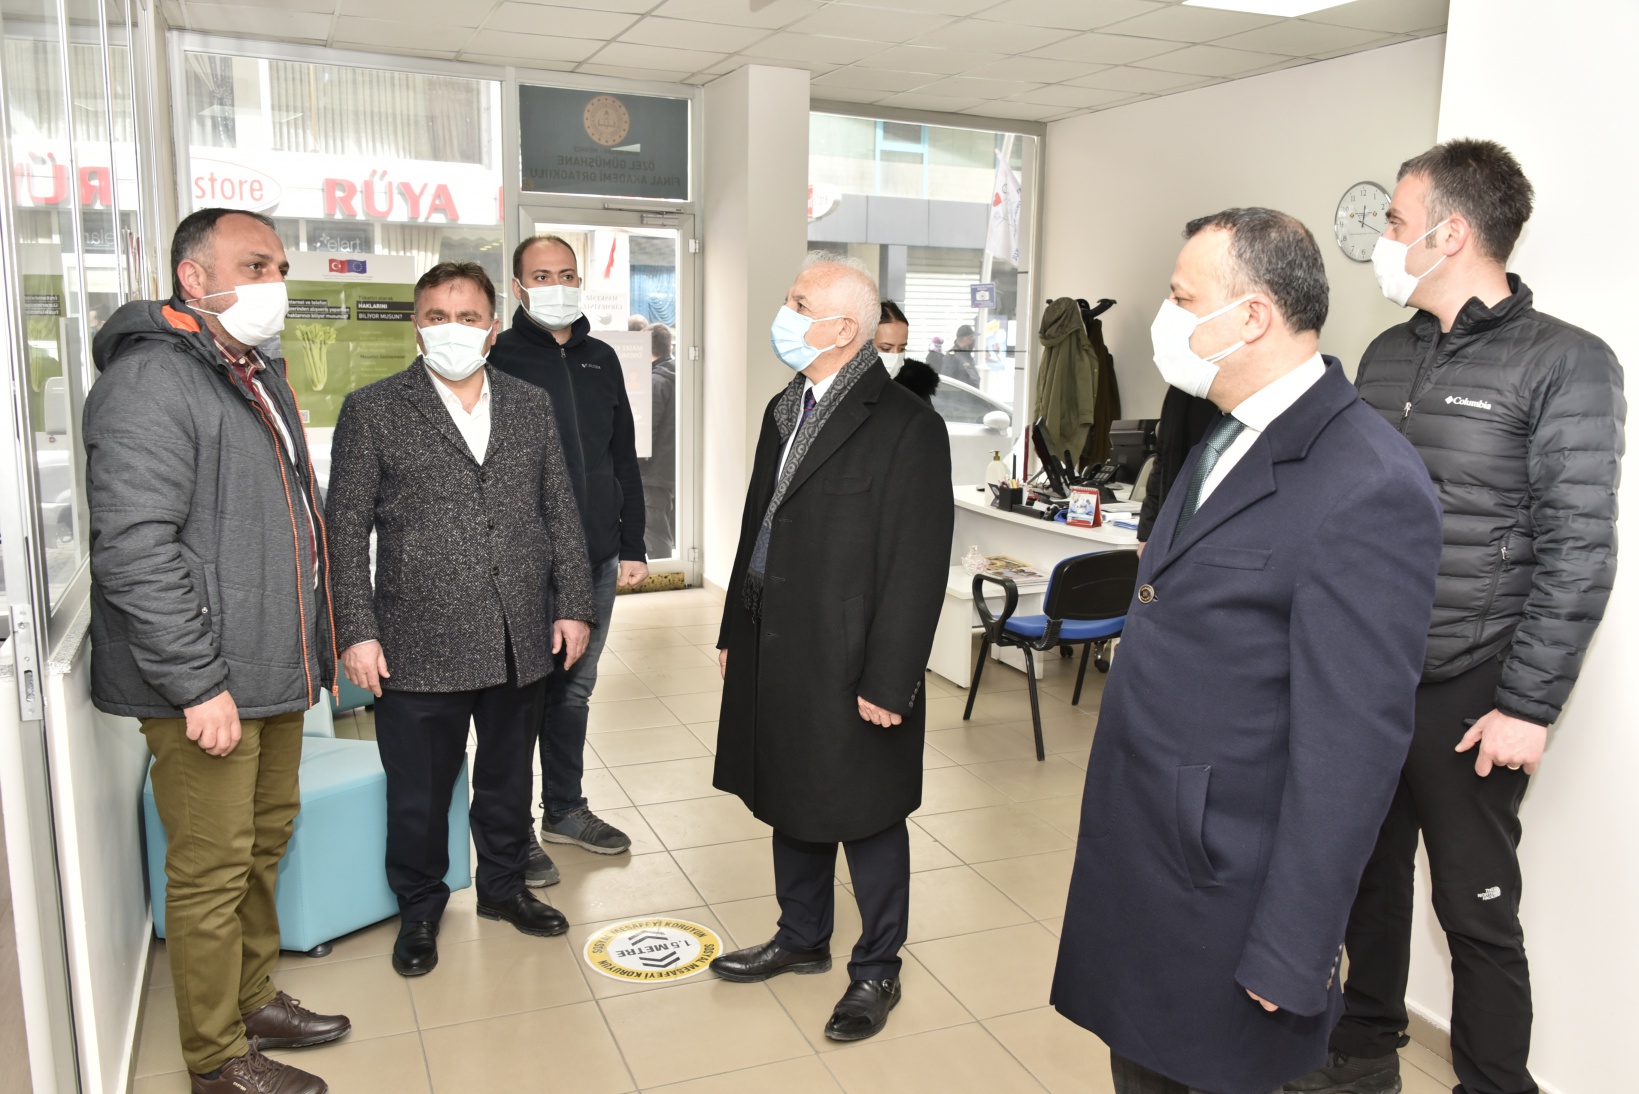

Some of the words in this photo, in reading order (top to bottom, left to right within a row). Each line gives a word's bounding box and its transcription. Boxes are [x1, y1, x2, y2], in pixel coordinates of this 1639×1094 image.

[194, 171, 264, 201] store
[1360, 189, 1367, 197] 12
[324, 169, 460, 222] RÜYA
[327, 235, 361, 253] elart
[1453, 396, 1492, 410] Columbia
[664, 921, 708, 938] KORUYUN
[617, 943, 669, 958] METRE
[670, 939, 692, 949] 1.5
[695, 943, 715, 965] SOSYAL
[597, 959, 642, 979] KORUYUN
[644, 962, 700, 980] MESAFEYİ
